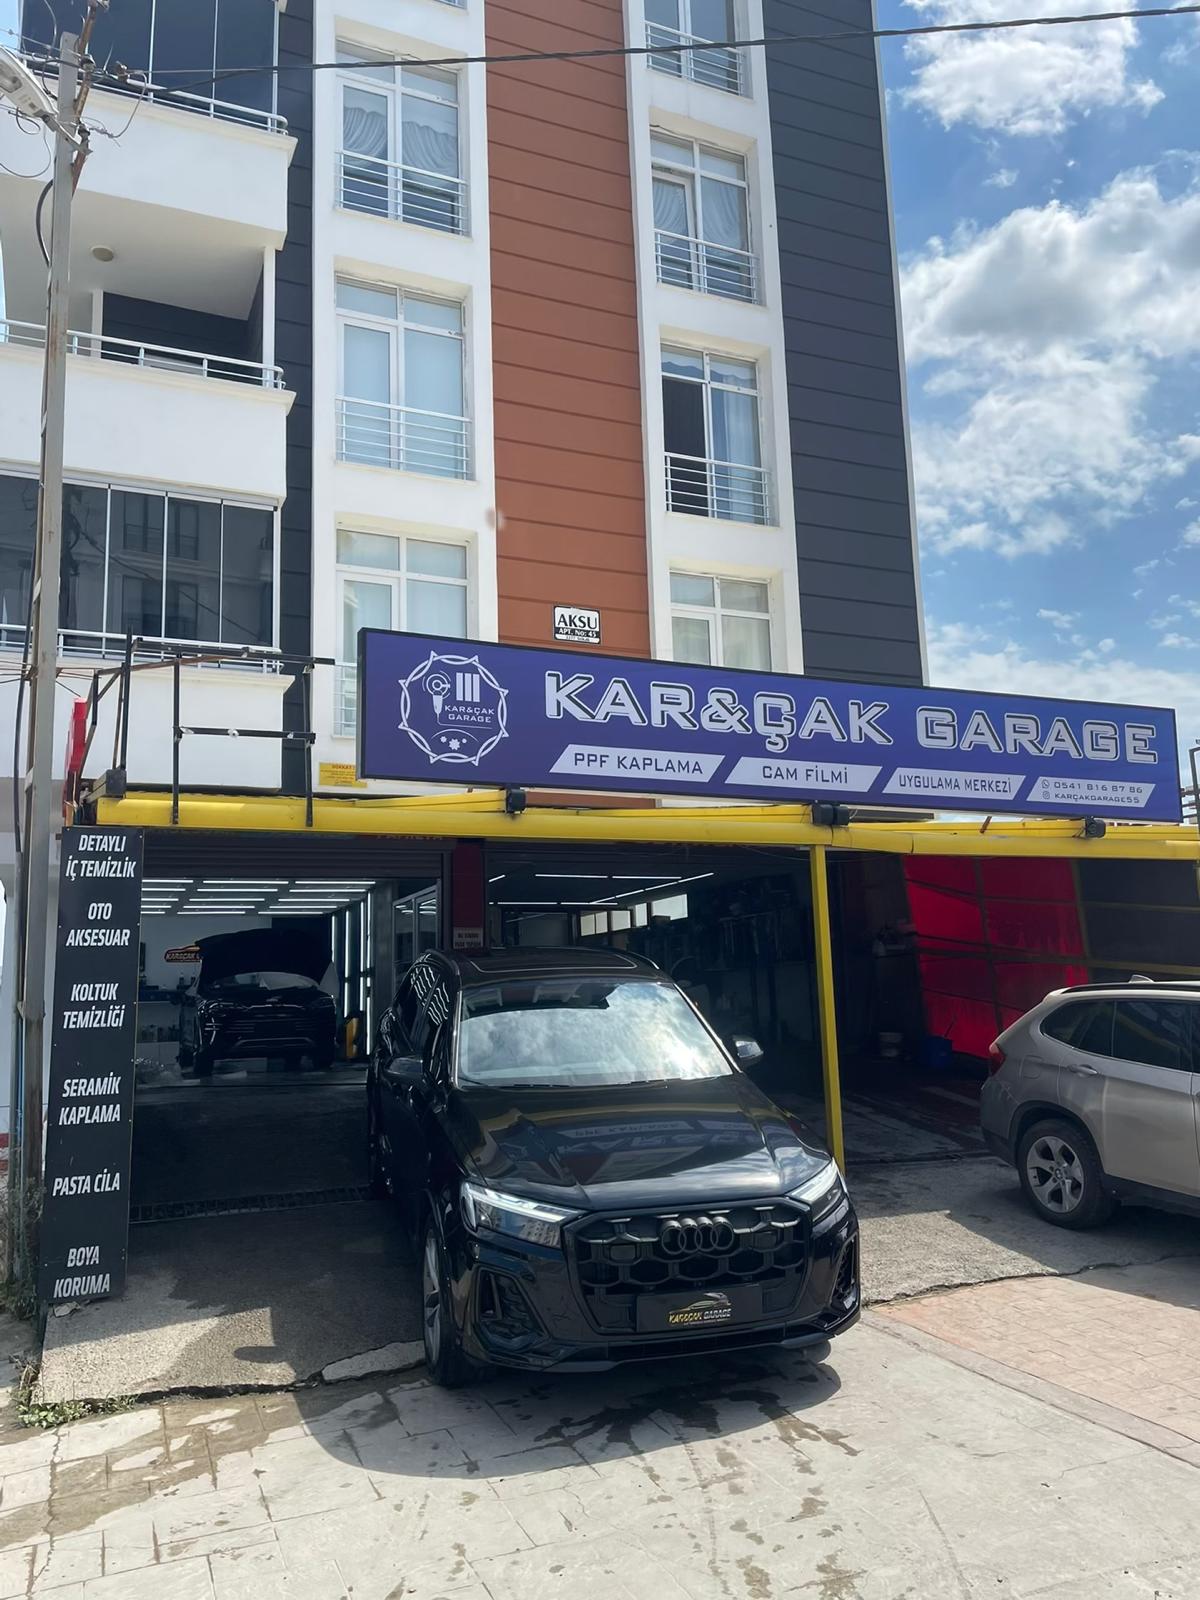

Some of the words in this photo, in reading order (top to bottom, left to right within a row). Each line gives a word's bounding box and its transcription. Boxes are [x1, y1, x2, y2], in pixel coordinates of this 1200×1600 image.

[557, 613, 598, 630] AKSU
[444, 704, 495, 716] KAR&ÇAK
[448, 713, 492, 724] GARAGE
[544, 670, 894, 753] KAR&ÇAK
[915, 705, 1159, 765] GARAGE
[573, 752, 609, 769] PPF
[616, 755, 704, 775] KAPLAMA
[762, 765, 798, 781] CAM
[805, 765, 849, 784] FİLMİ
[898, 774, 961, 791] UYGULAMA
[964, 777, 1012, 793] MERKEZİ
[1054, 781, 1081, 789] 0541
[1087, 783, 1108, 791] 816
[78, 834, 126, 852] DETAYLI
[65, 855, 79, 881] İÇ
[80, 856, 136, 878] TEMİZLİK
[88, 902, 112, 920] OTO
[65, 929, 130, 947] AKSESUAR
[70, 983, 119, 1001] KOLTUK
[63, 1005, 125, 1029] TEMİZLİĞİ
[62, 1071, 121, 1097] SERAMİK
[58, 1103, 121, 1126] KAPLAMA
[52, 1175, 91, 1197] PASTA
[94, 1168, 121, 1194] CİLA
[67, 1245, 100, 1268] BOYA
[53, 1273, 111, 1298] KORUMA
